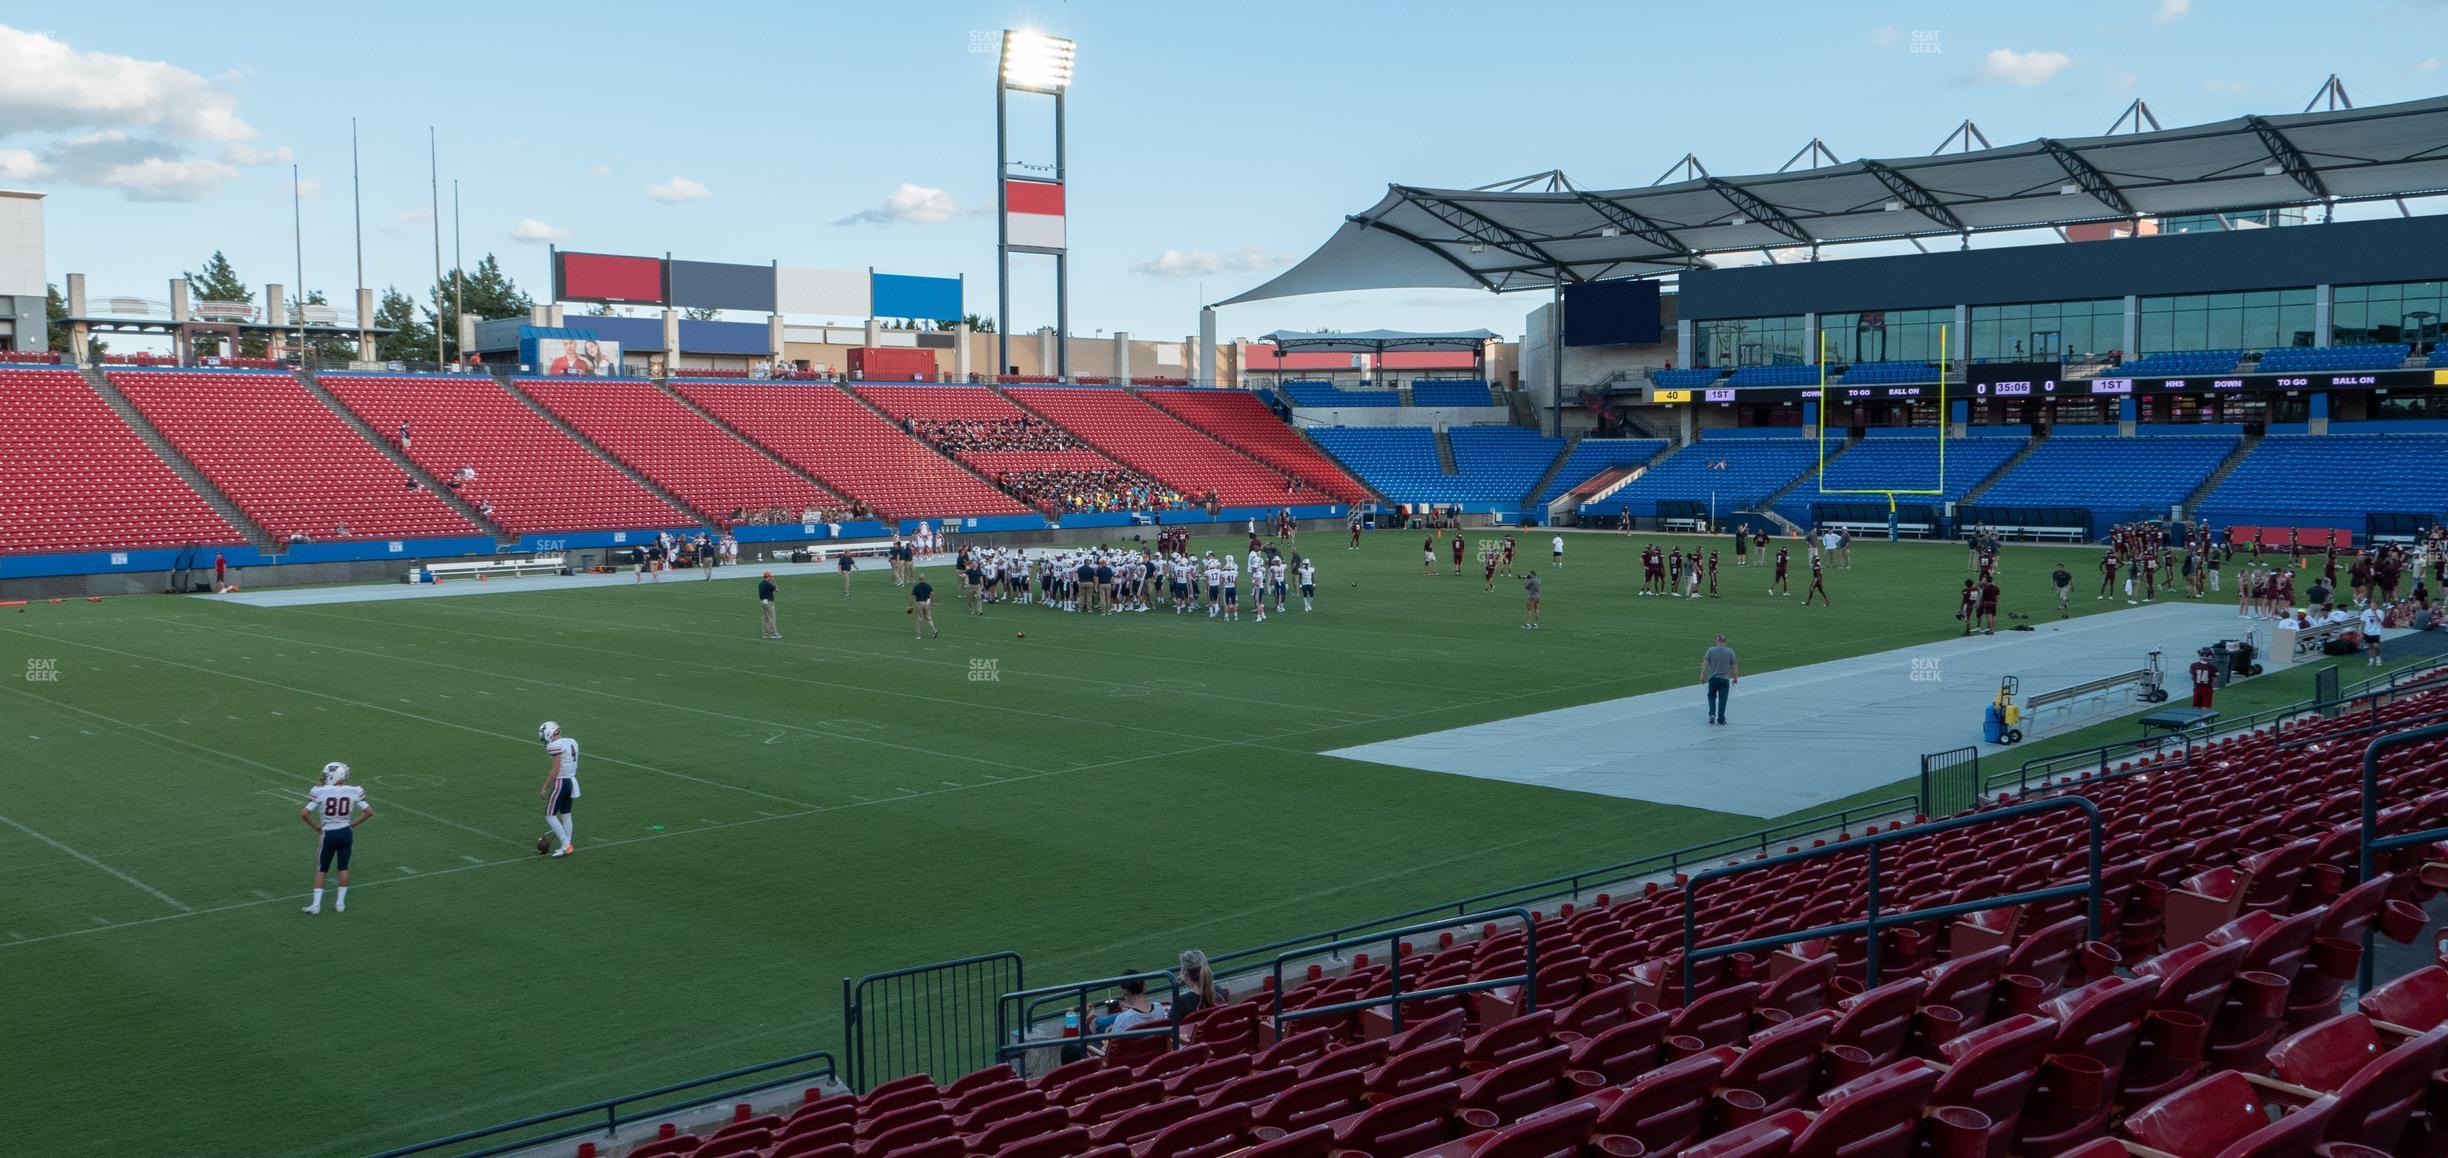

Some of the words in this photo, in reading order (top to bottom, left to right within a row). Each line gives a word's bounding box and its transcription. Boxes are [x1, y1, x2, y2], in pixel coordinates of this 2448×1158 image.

[2100, 380, 2123, 389] 1ST
[2214, 380, 2242, 388] DOWN
[2332, 377, 2357, 385] BALL
[2359, 376, 2375, 384] ON
[1977, 384, 1986, 394] 0
[1998, 383, 2028, 392] 35:06
[2045, 381, 2054, 391] 0
[1666, 391, 1678, 400] 40
[1711, 390, 1729, 399] 1ST
[1848, 389, 1859, 397] TO
[1226, 574, 1235, 584] 41
[2195, 669, 2209, 684] 14
[324, 796, 351, 816] 80
